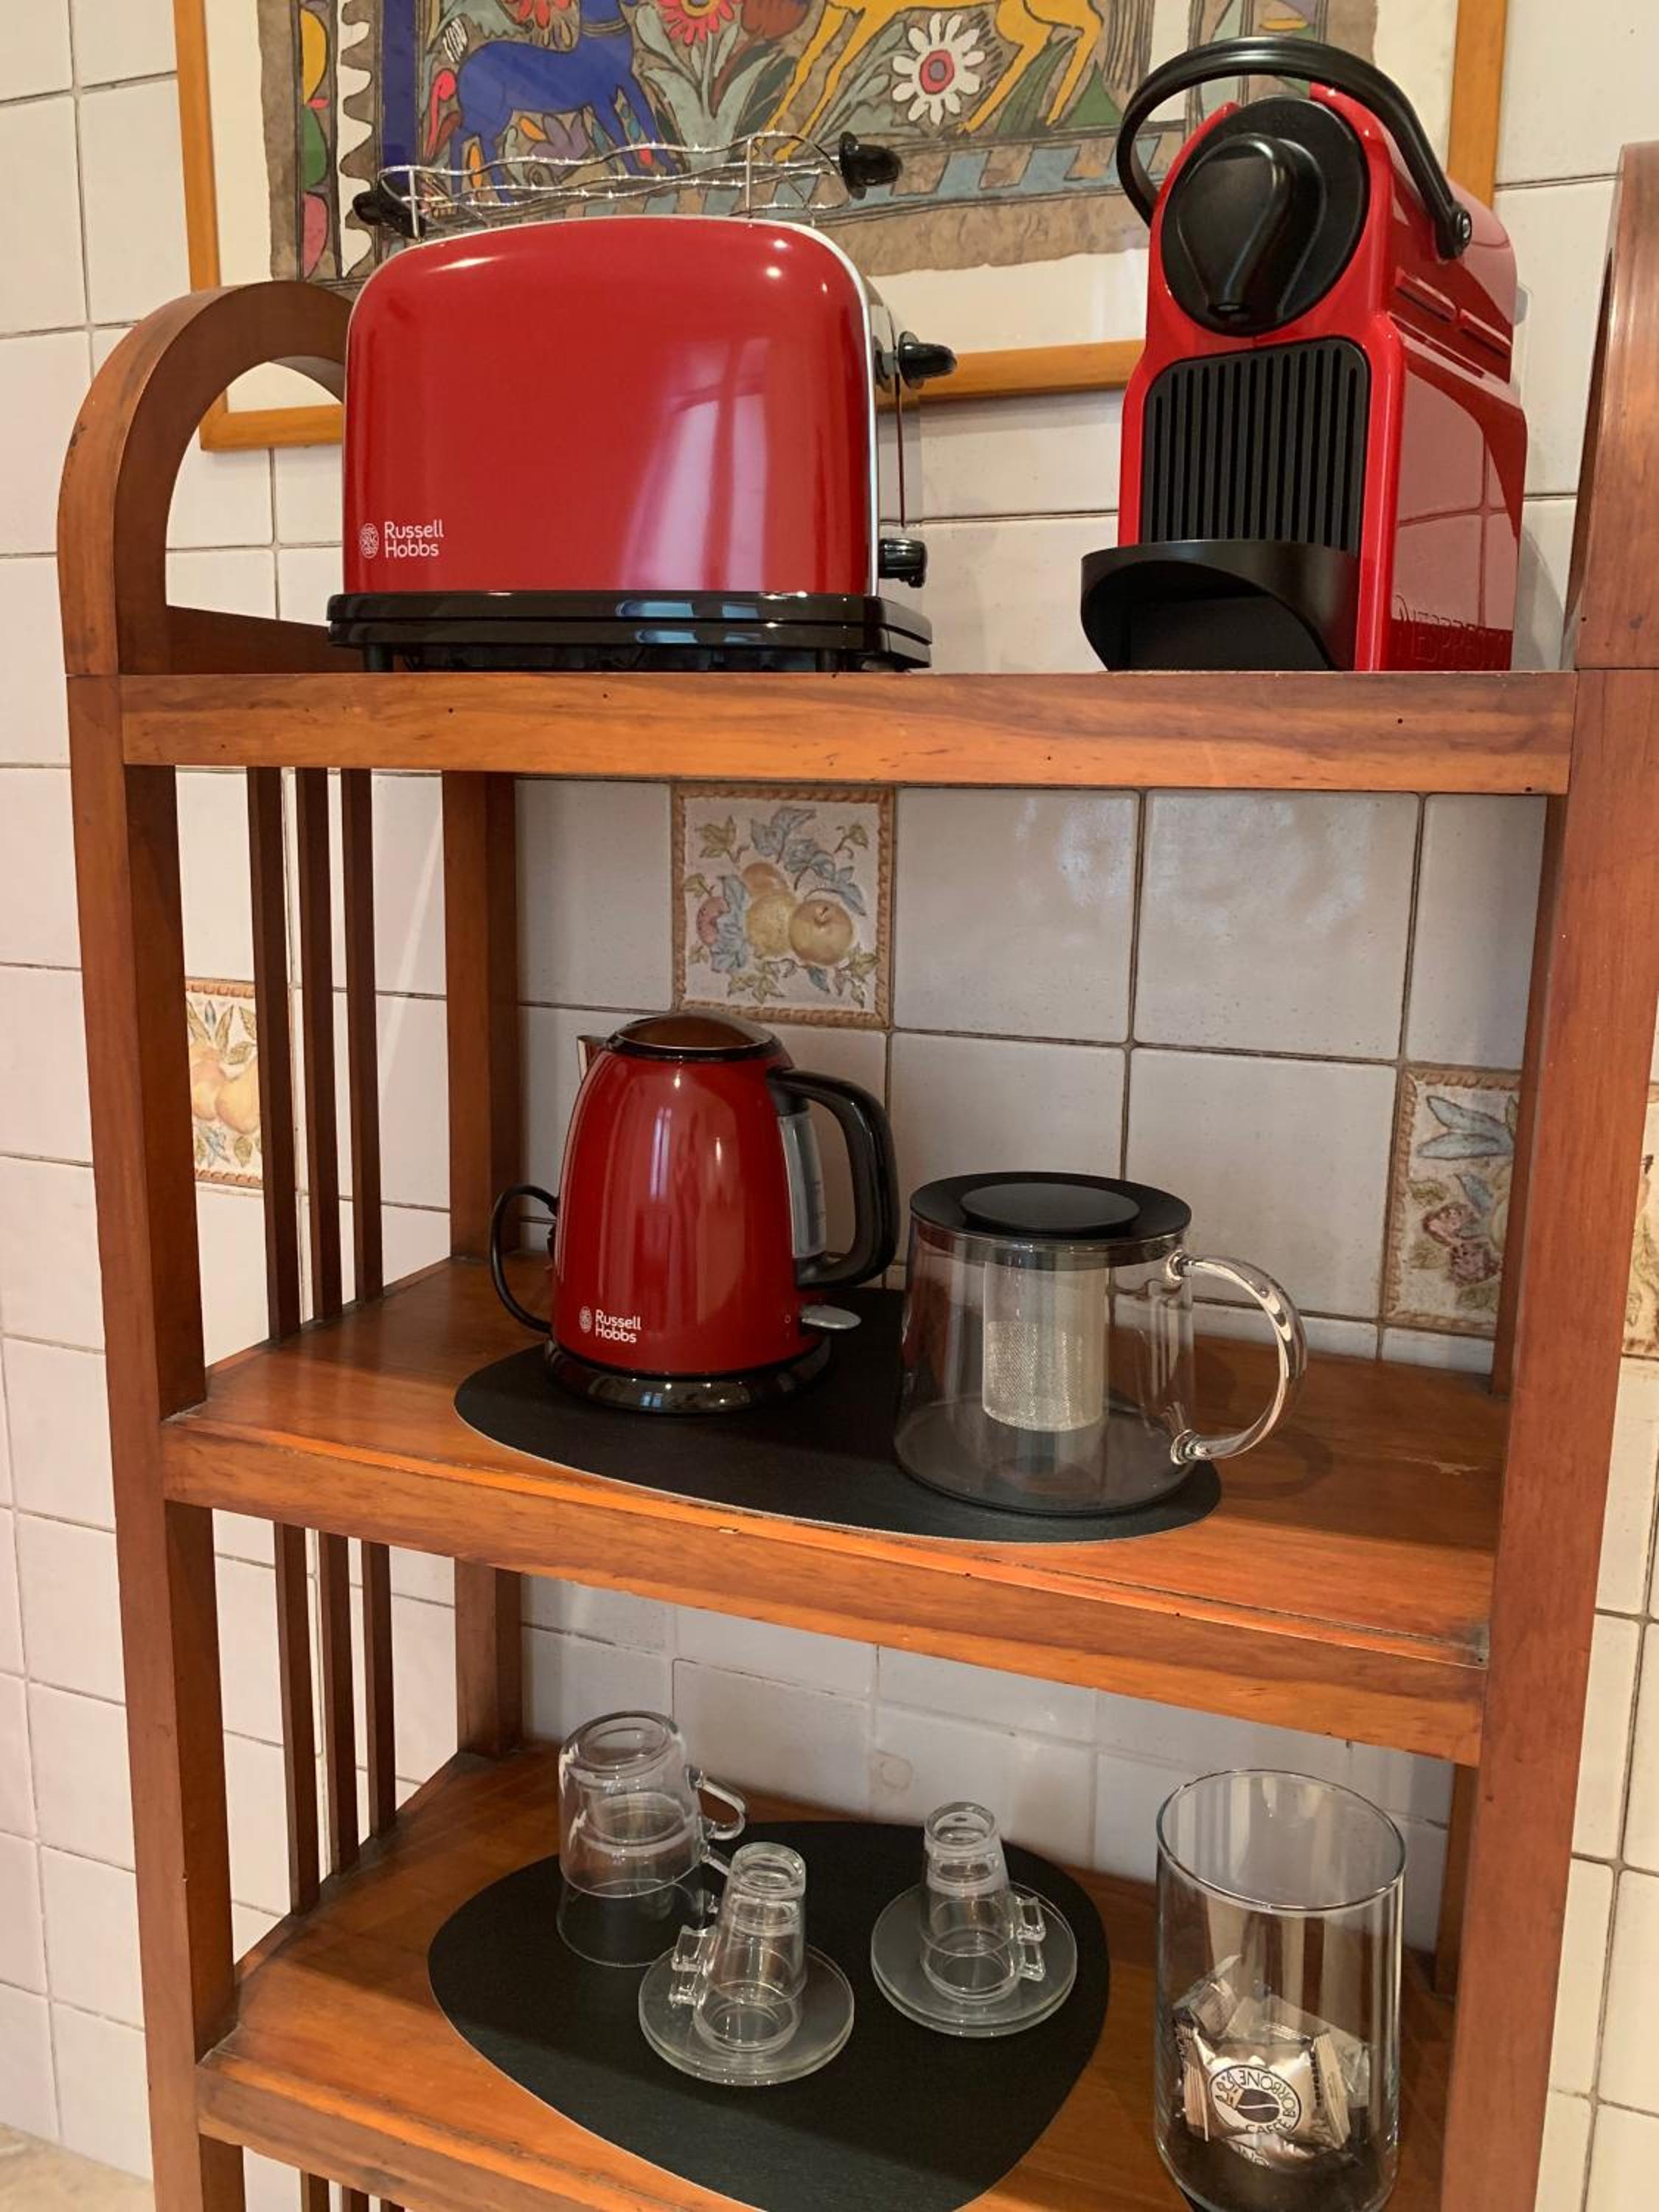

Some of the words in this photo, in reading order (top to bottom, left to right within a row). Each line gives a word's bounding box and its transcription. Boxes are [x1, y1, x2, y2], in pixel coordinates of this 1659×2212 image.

[383, 519, 445, 540] Russell
[384, 539, 439, 558] Hobbs
[595, 1309, 642, 1331] Russell
[595, 1323, 637, 1343] Hobbs
[1238, 2070, 1296, 2118] BORBONE
